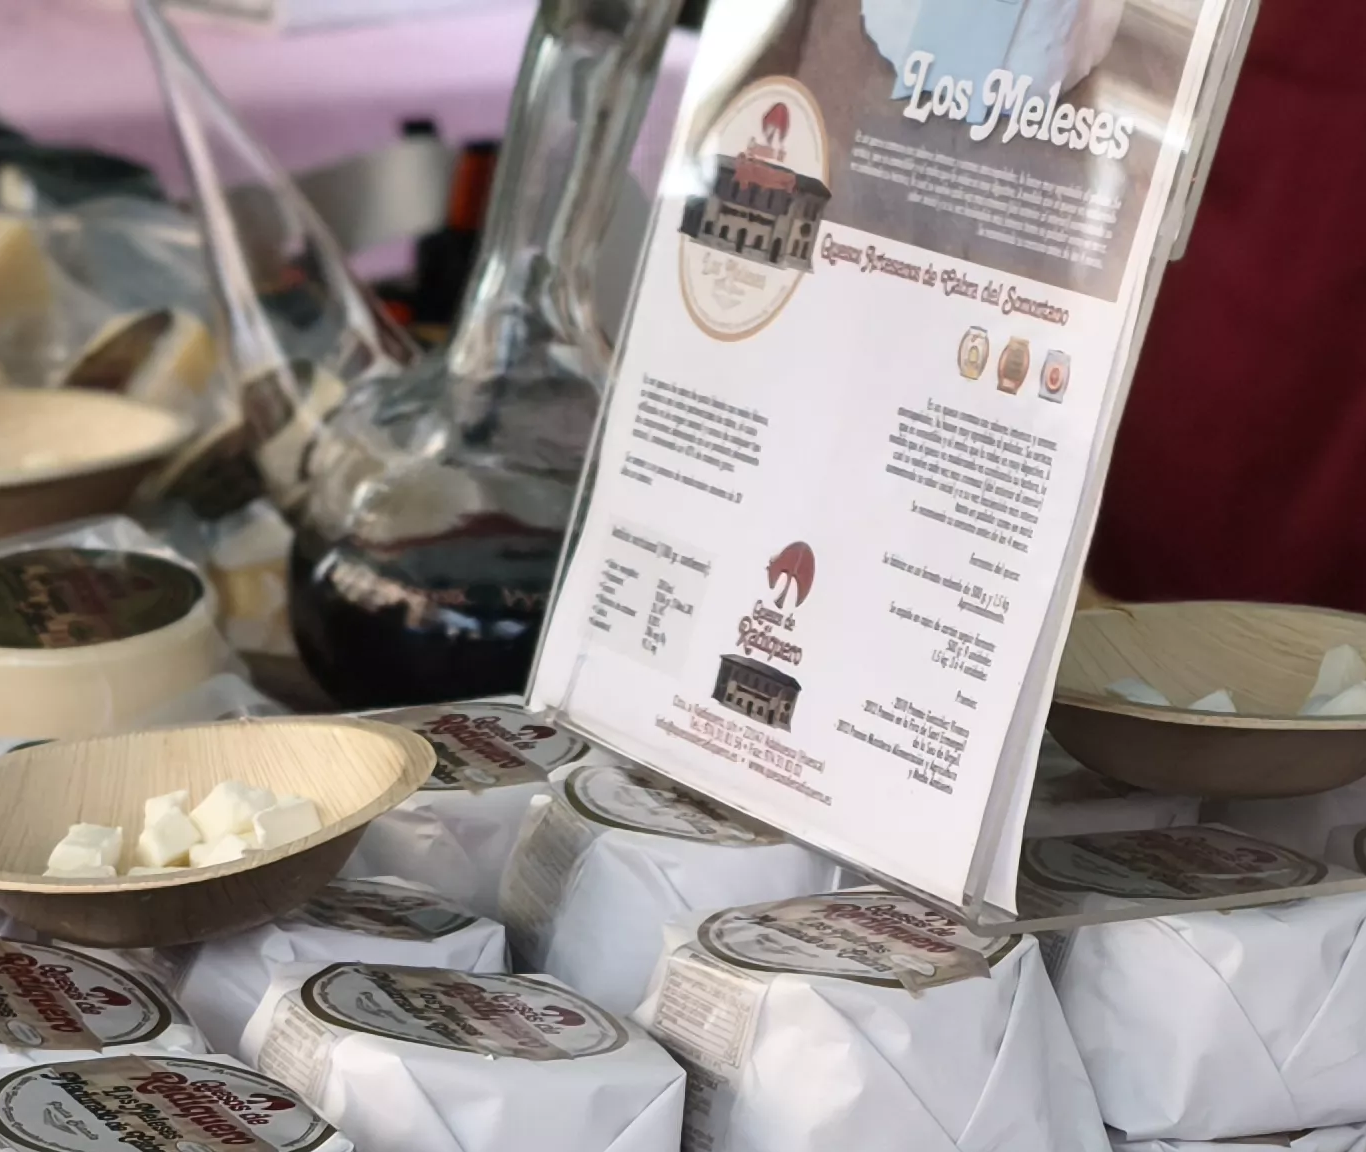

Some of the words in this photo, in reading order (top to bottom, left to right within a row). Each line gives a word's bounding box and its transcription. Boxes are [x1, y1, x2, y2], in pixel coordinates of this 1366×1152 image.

[902, 50, 973, 123] Los
[970, 69, 1134, 160] Meleses
[923, 264, 938, 286] de
[981, 282, 1003, 306] del
[128, 1071, 256, 1145] Radiquero
[239, 1113, 272, 1125] de
